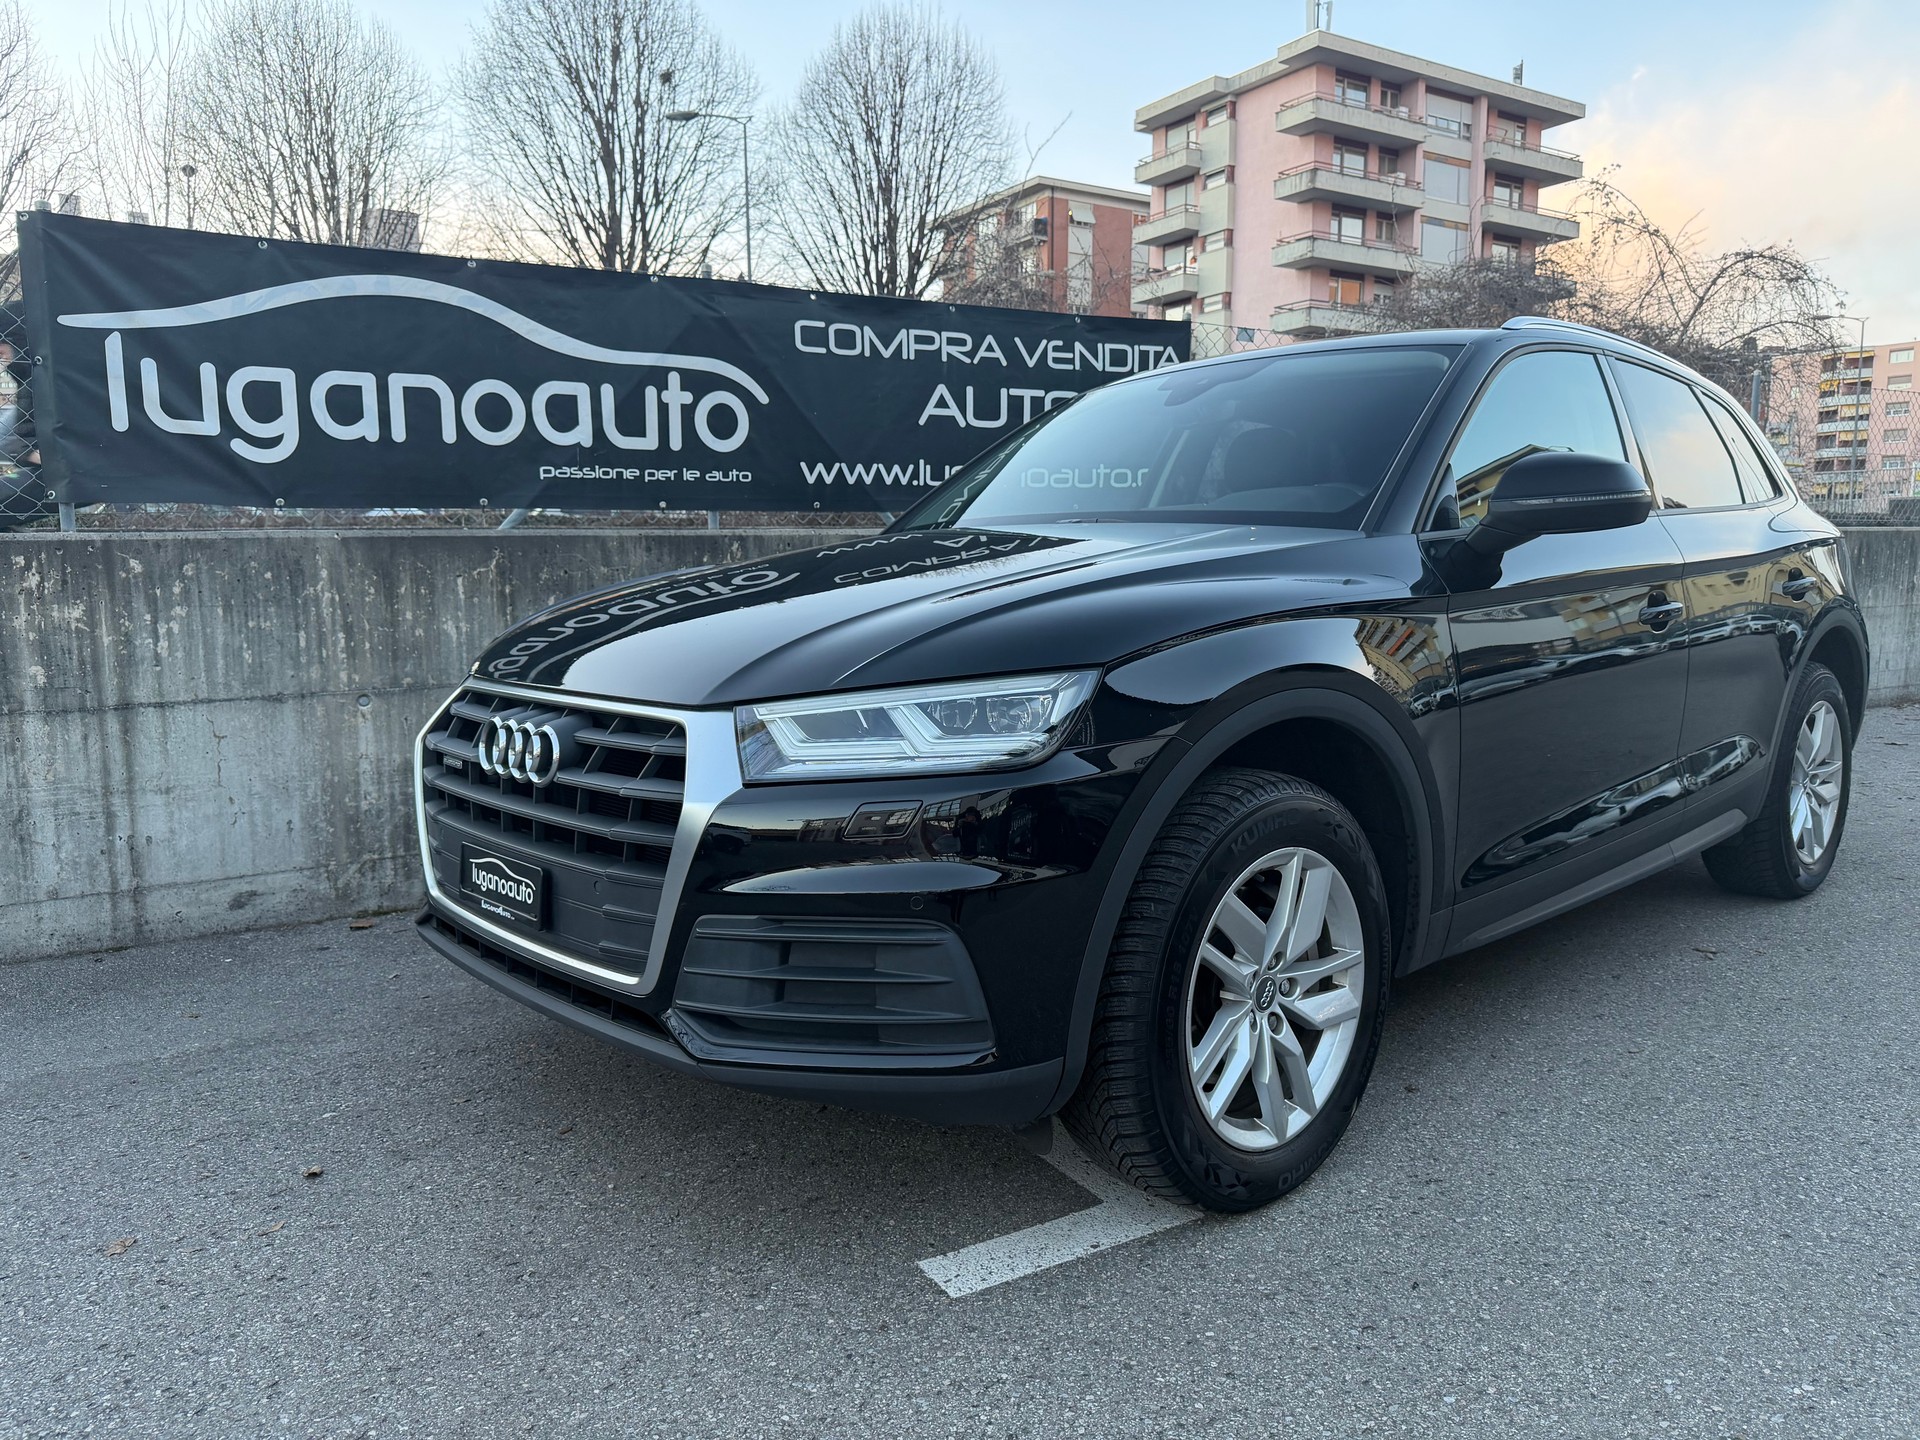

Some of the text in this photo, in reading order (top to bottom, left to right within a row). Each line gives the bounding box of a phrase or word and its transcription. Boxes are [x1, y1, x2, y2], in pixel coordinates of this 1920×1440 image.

[795, 320, 1180, 373] COMPRA VENDITA
[105, 331, 750, 464] luganoauto
[539, 465, 752, 483] passione per le auto
[1230, 808, 1299, 857] KUMHO
[472, 863, 533, 904] luganoauto
